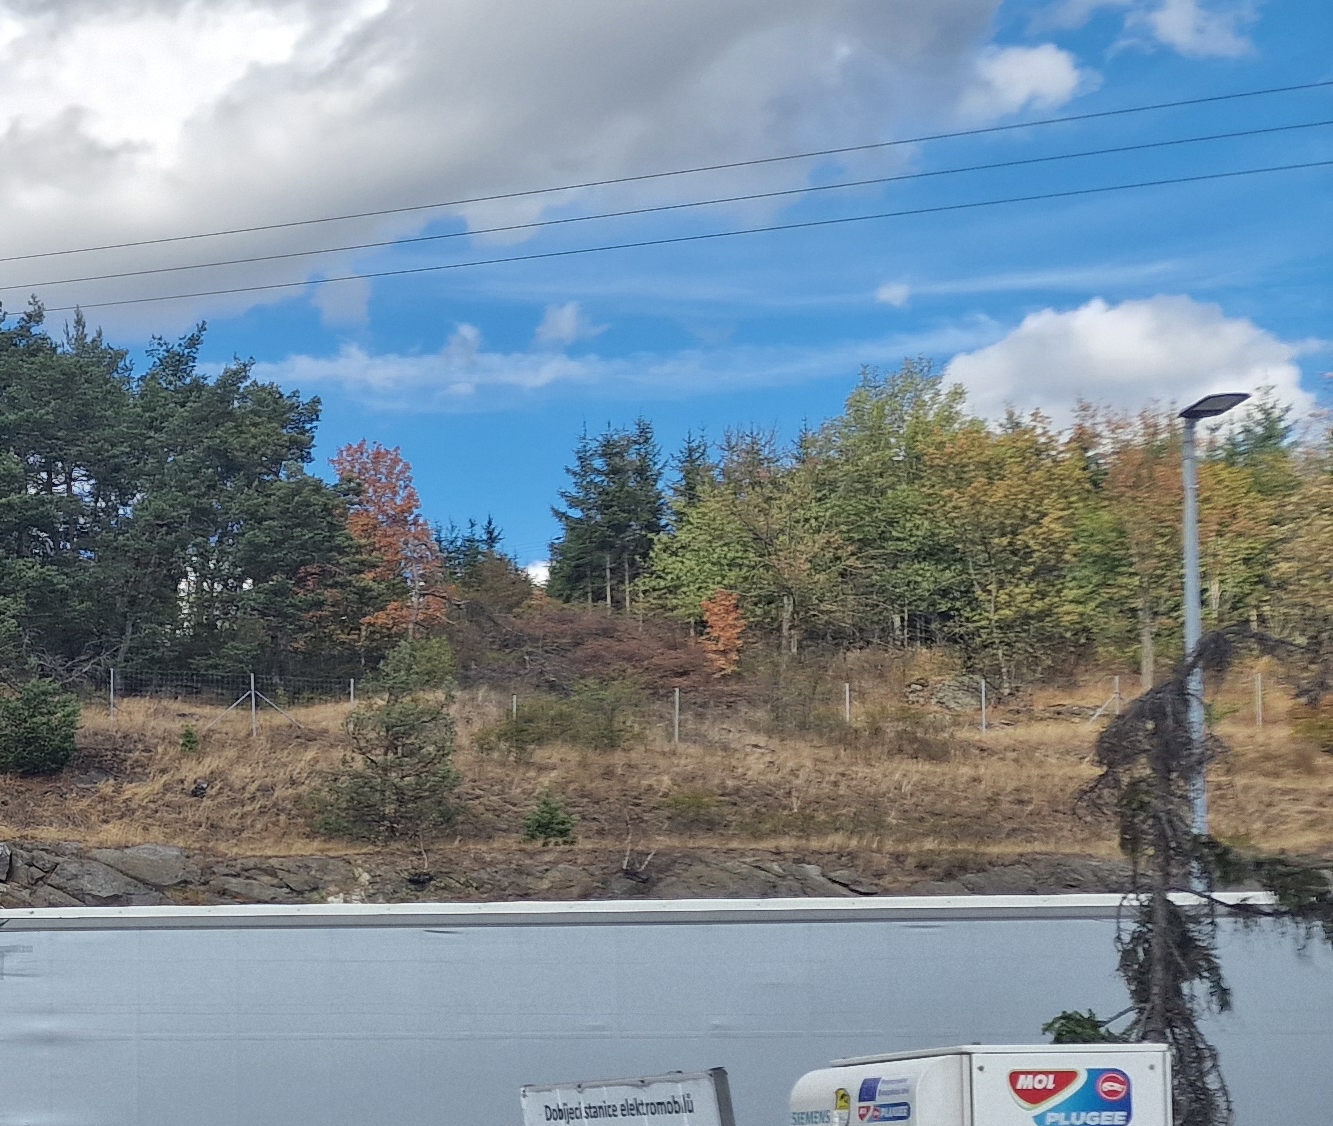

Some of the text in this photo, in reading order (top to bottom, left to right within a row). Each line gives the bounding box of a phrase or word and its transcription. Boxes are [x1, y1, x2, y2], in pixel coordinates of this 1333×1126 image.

[1016, 1074, 1055, 1090] MOL
[584, 1101, 619, 1120] stanice
[792, 1110, 830, 1125] SIEMENS
[1045, 1111, 1127, 1126] PLUGEE
